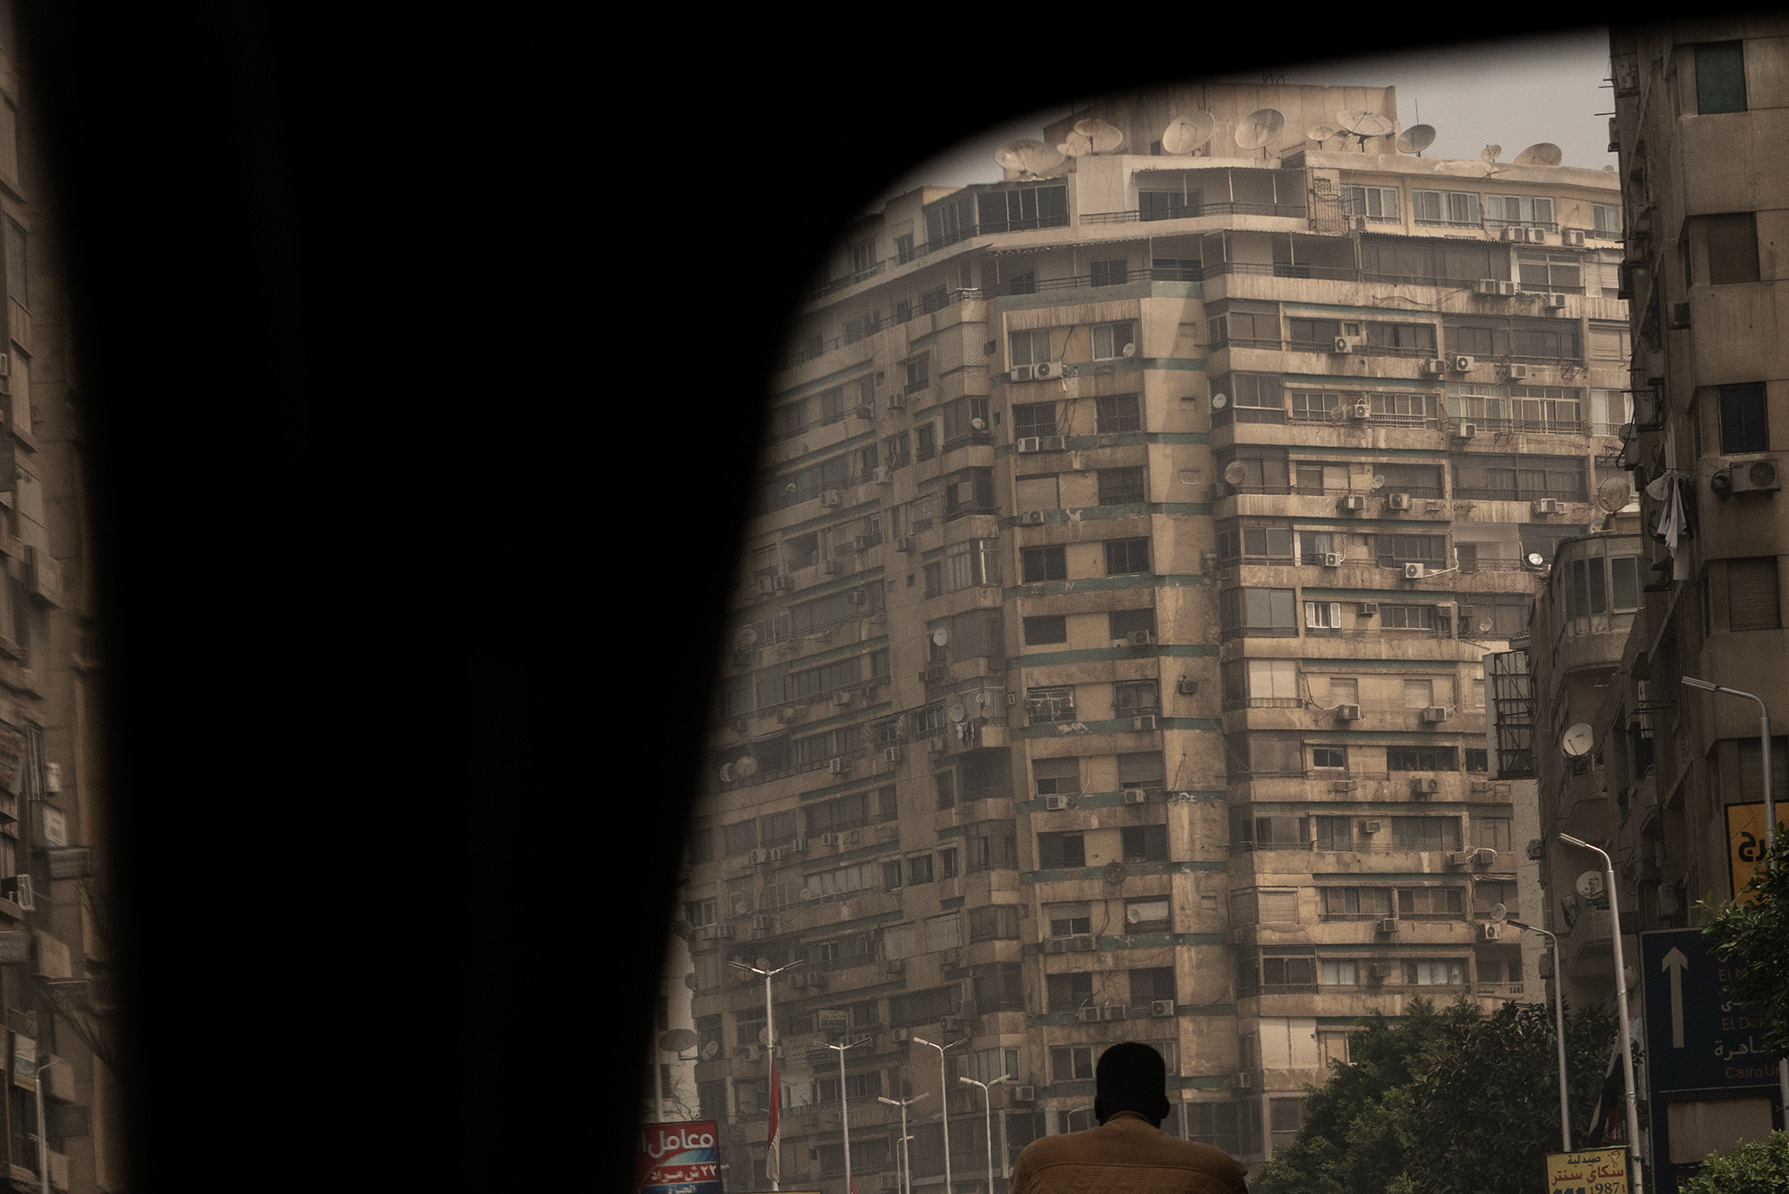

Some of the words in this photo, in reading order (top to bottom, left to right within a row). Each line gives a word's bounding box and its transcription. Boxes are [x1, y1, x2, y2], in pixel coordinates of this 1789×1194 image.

[1725, 1066, 1764, 1080] Cairo
[647, 1128, 714, 1158] معامل
[1567, 1155, 1601, 1167] صيدلية
[1552, 1170, 1583, 1186] سنتر
